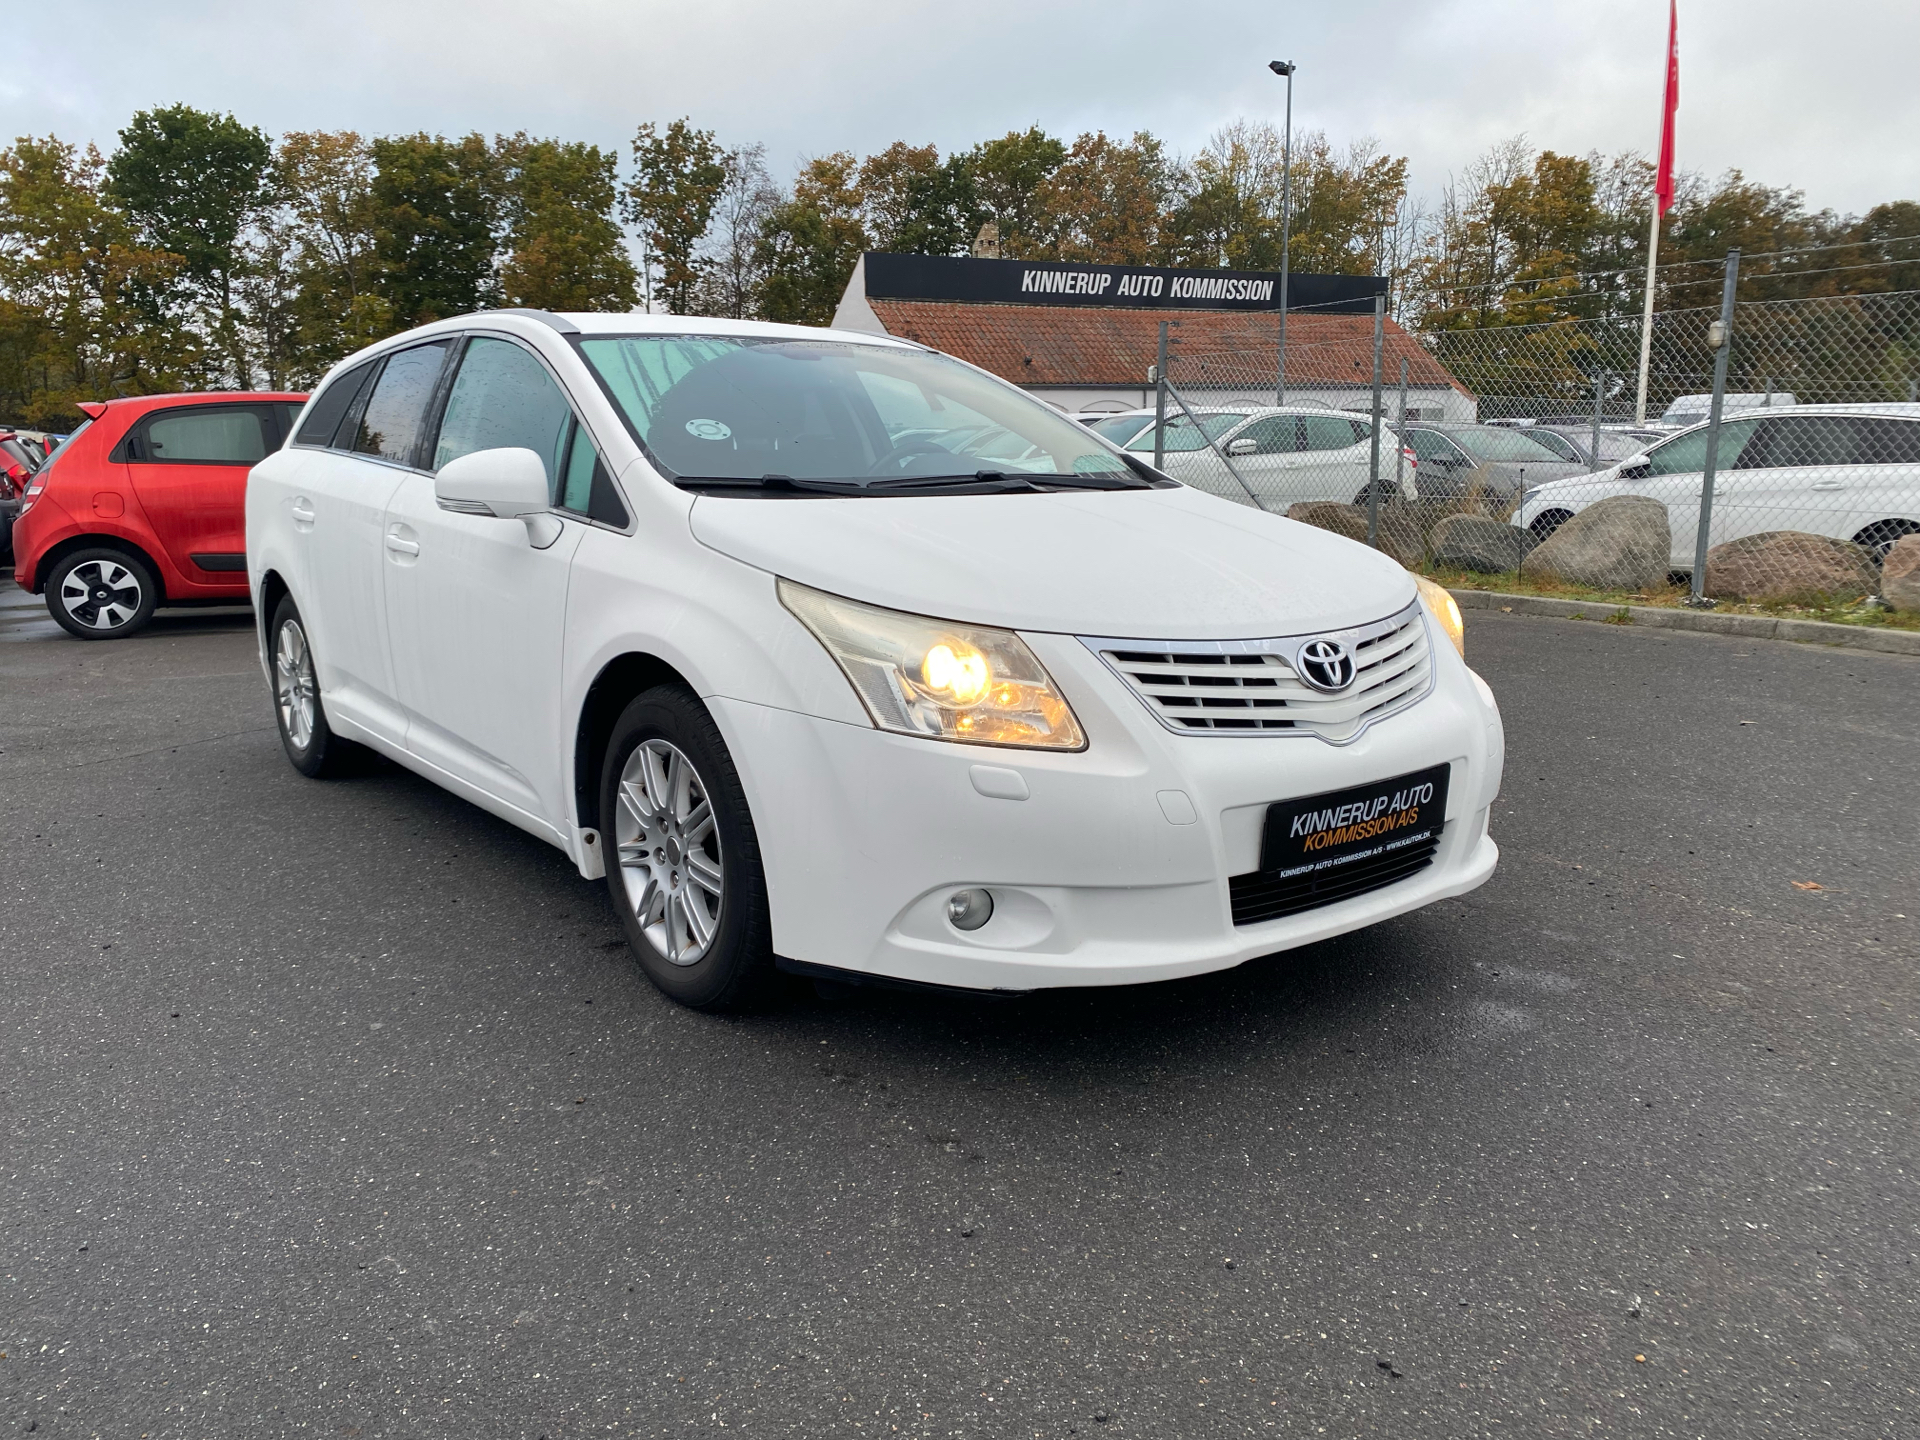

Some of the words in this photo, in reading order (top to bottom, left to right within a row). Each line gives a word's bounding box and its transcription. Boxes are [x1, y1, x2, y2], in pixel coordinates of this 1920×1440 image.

[1021, 270, 1112, 295] KINNERUP
[1117, 274, 1164, 297] AUTO
[1170, 276, 1274, 301] KOMMISSION
[1290, 795, 1389, 838] KINNERUP
[1389, 782, 1433, 814] AUTO
[1303, 814, 1397, 853] KOMMISSION
[1396, 807, 1418, 828] A/S
[1280, 864, 1315, 878] KINNERUP
[1314, 860, 1333, 871] AUTO
[1333, 850, 1372, 865] KOMMISSION
